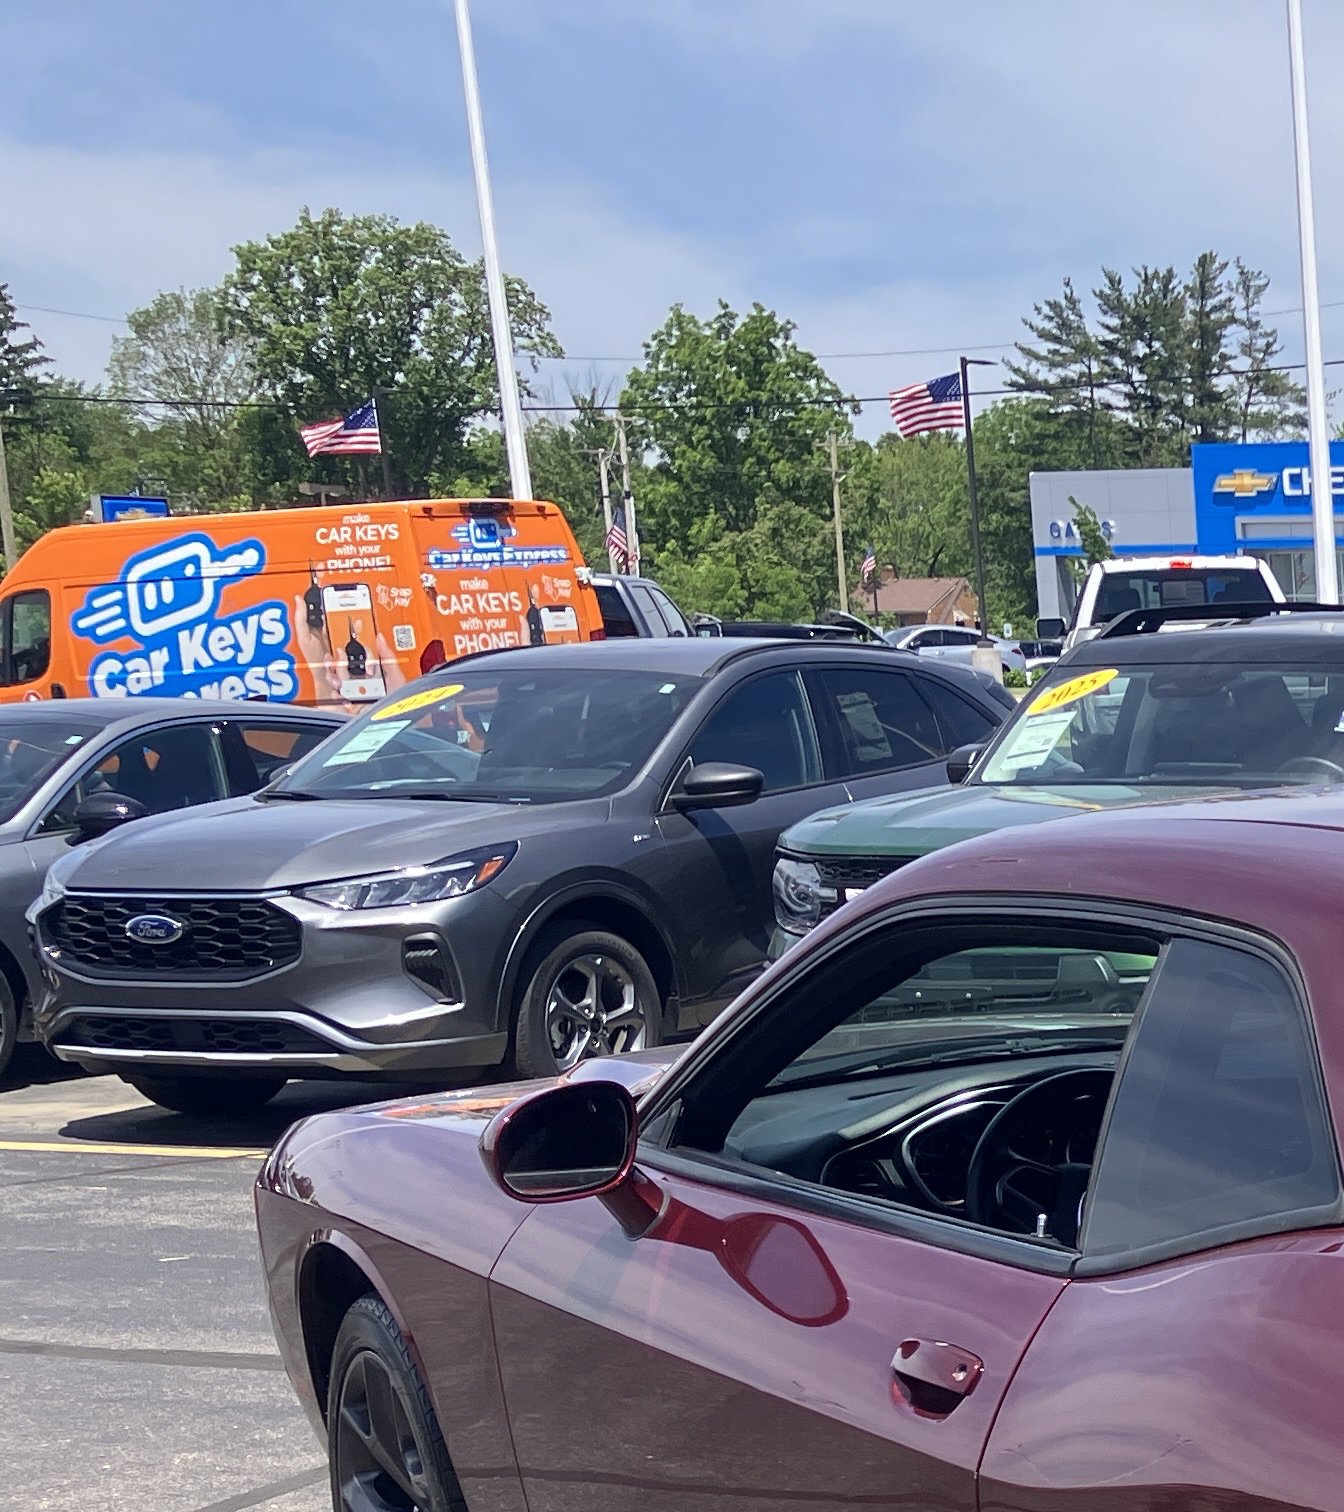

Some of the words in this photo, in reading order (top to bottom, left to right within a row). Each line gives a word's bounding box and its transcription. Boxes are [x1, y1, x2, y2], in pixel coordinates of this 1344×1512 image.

[316, 526, 352, 545] CAR
[355, 523, 400, 542] KEYS
[335, 544, 358, 556] with
[359, 544, 382, 556] your
[428, 550, 461, 569] Car
[461, 548, 501, 570] Keys
[326, 555, 393, 574] PHONE!
[459, 577, 489, 591] make
[436, 595, 476, 616] CAR
[475, 591, 523, 613] KEYS
[459, 616, 484, 631] with
[484, 617, 508, 632] your
[93, 647, 170, 699] Car
[178, 607, 286, 675] Keys
[137, 920, 168, 938] Ford
